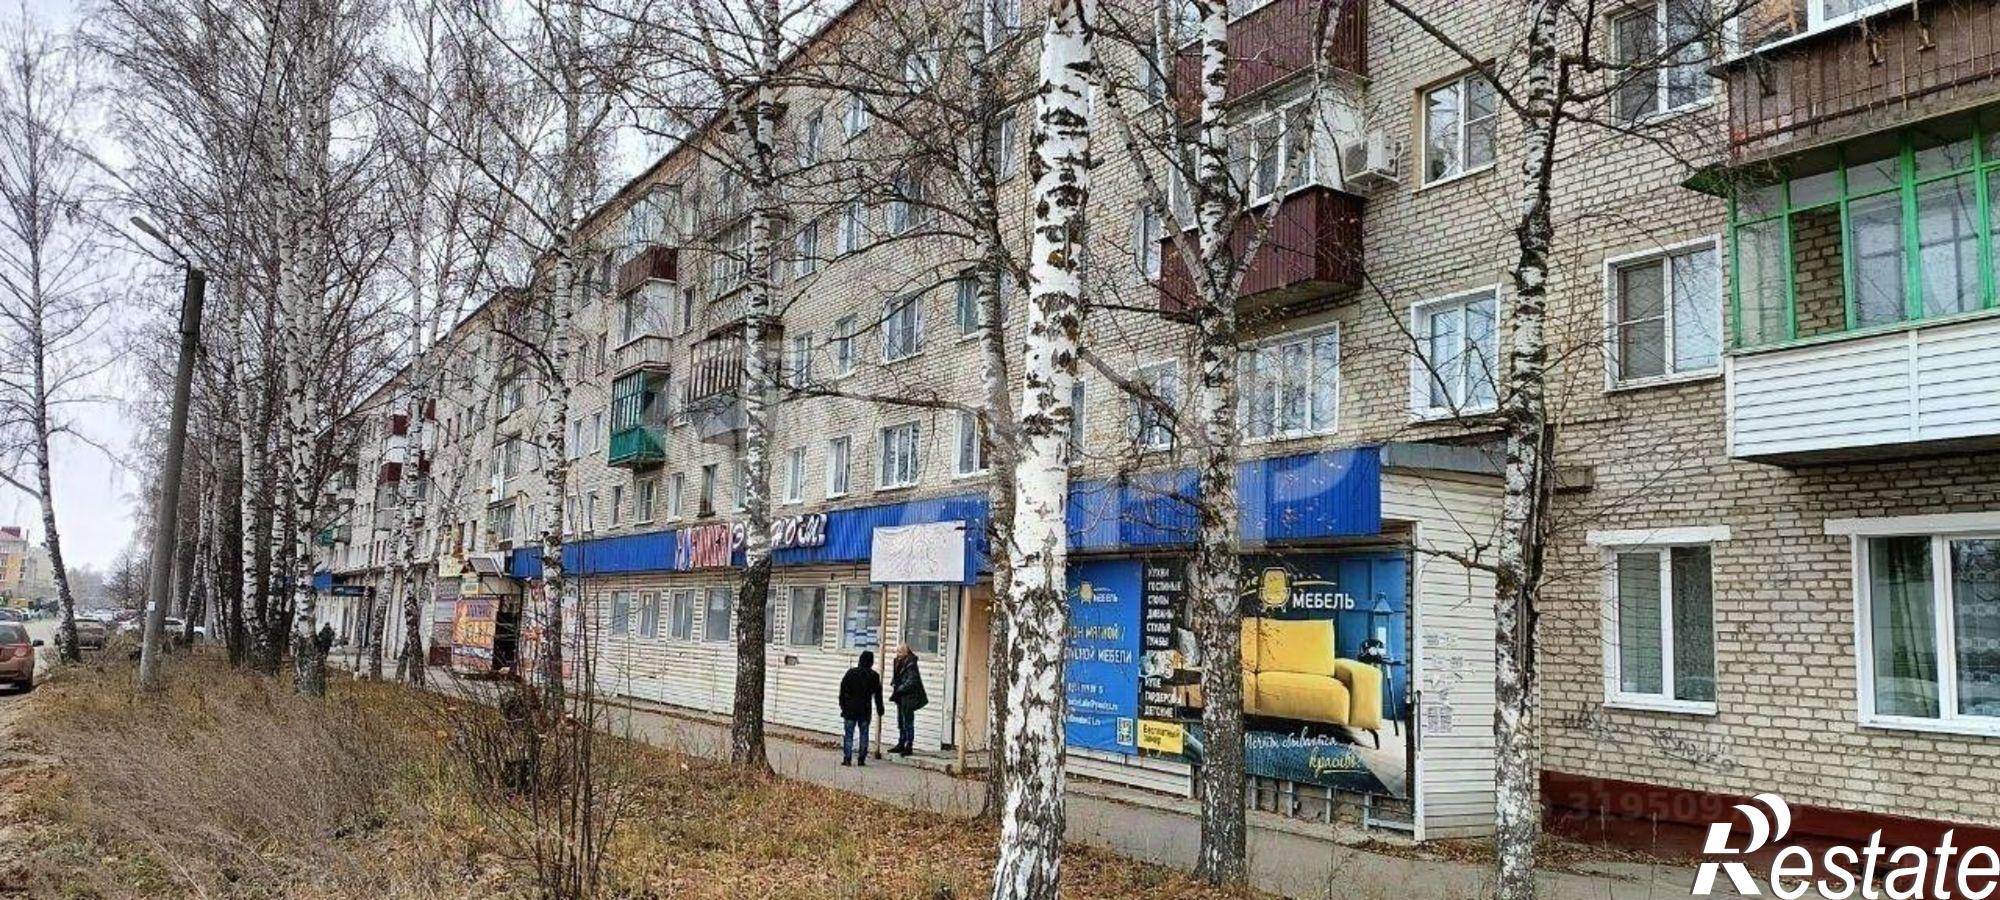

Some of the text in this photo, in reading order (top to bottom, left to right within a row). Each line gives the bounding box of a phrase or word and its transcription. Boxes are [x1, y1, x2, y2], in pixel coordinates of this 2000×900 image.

[1147, 581, 1181, 592] ГОСТИНЫЕ
[1292, 592, 1355, 610] МЕБЕЛЬ
[1146, 623, 1171, 633] СТУЛЬЯ
[1099, 648, 1132, 664] МЕБЕЛИ
